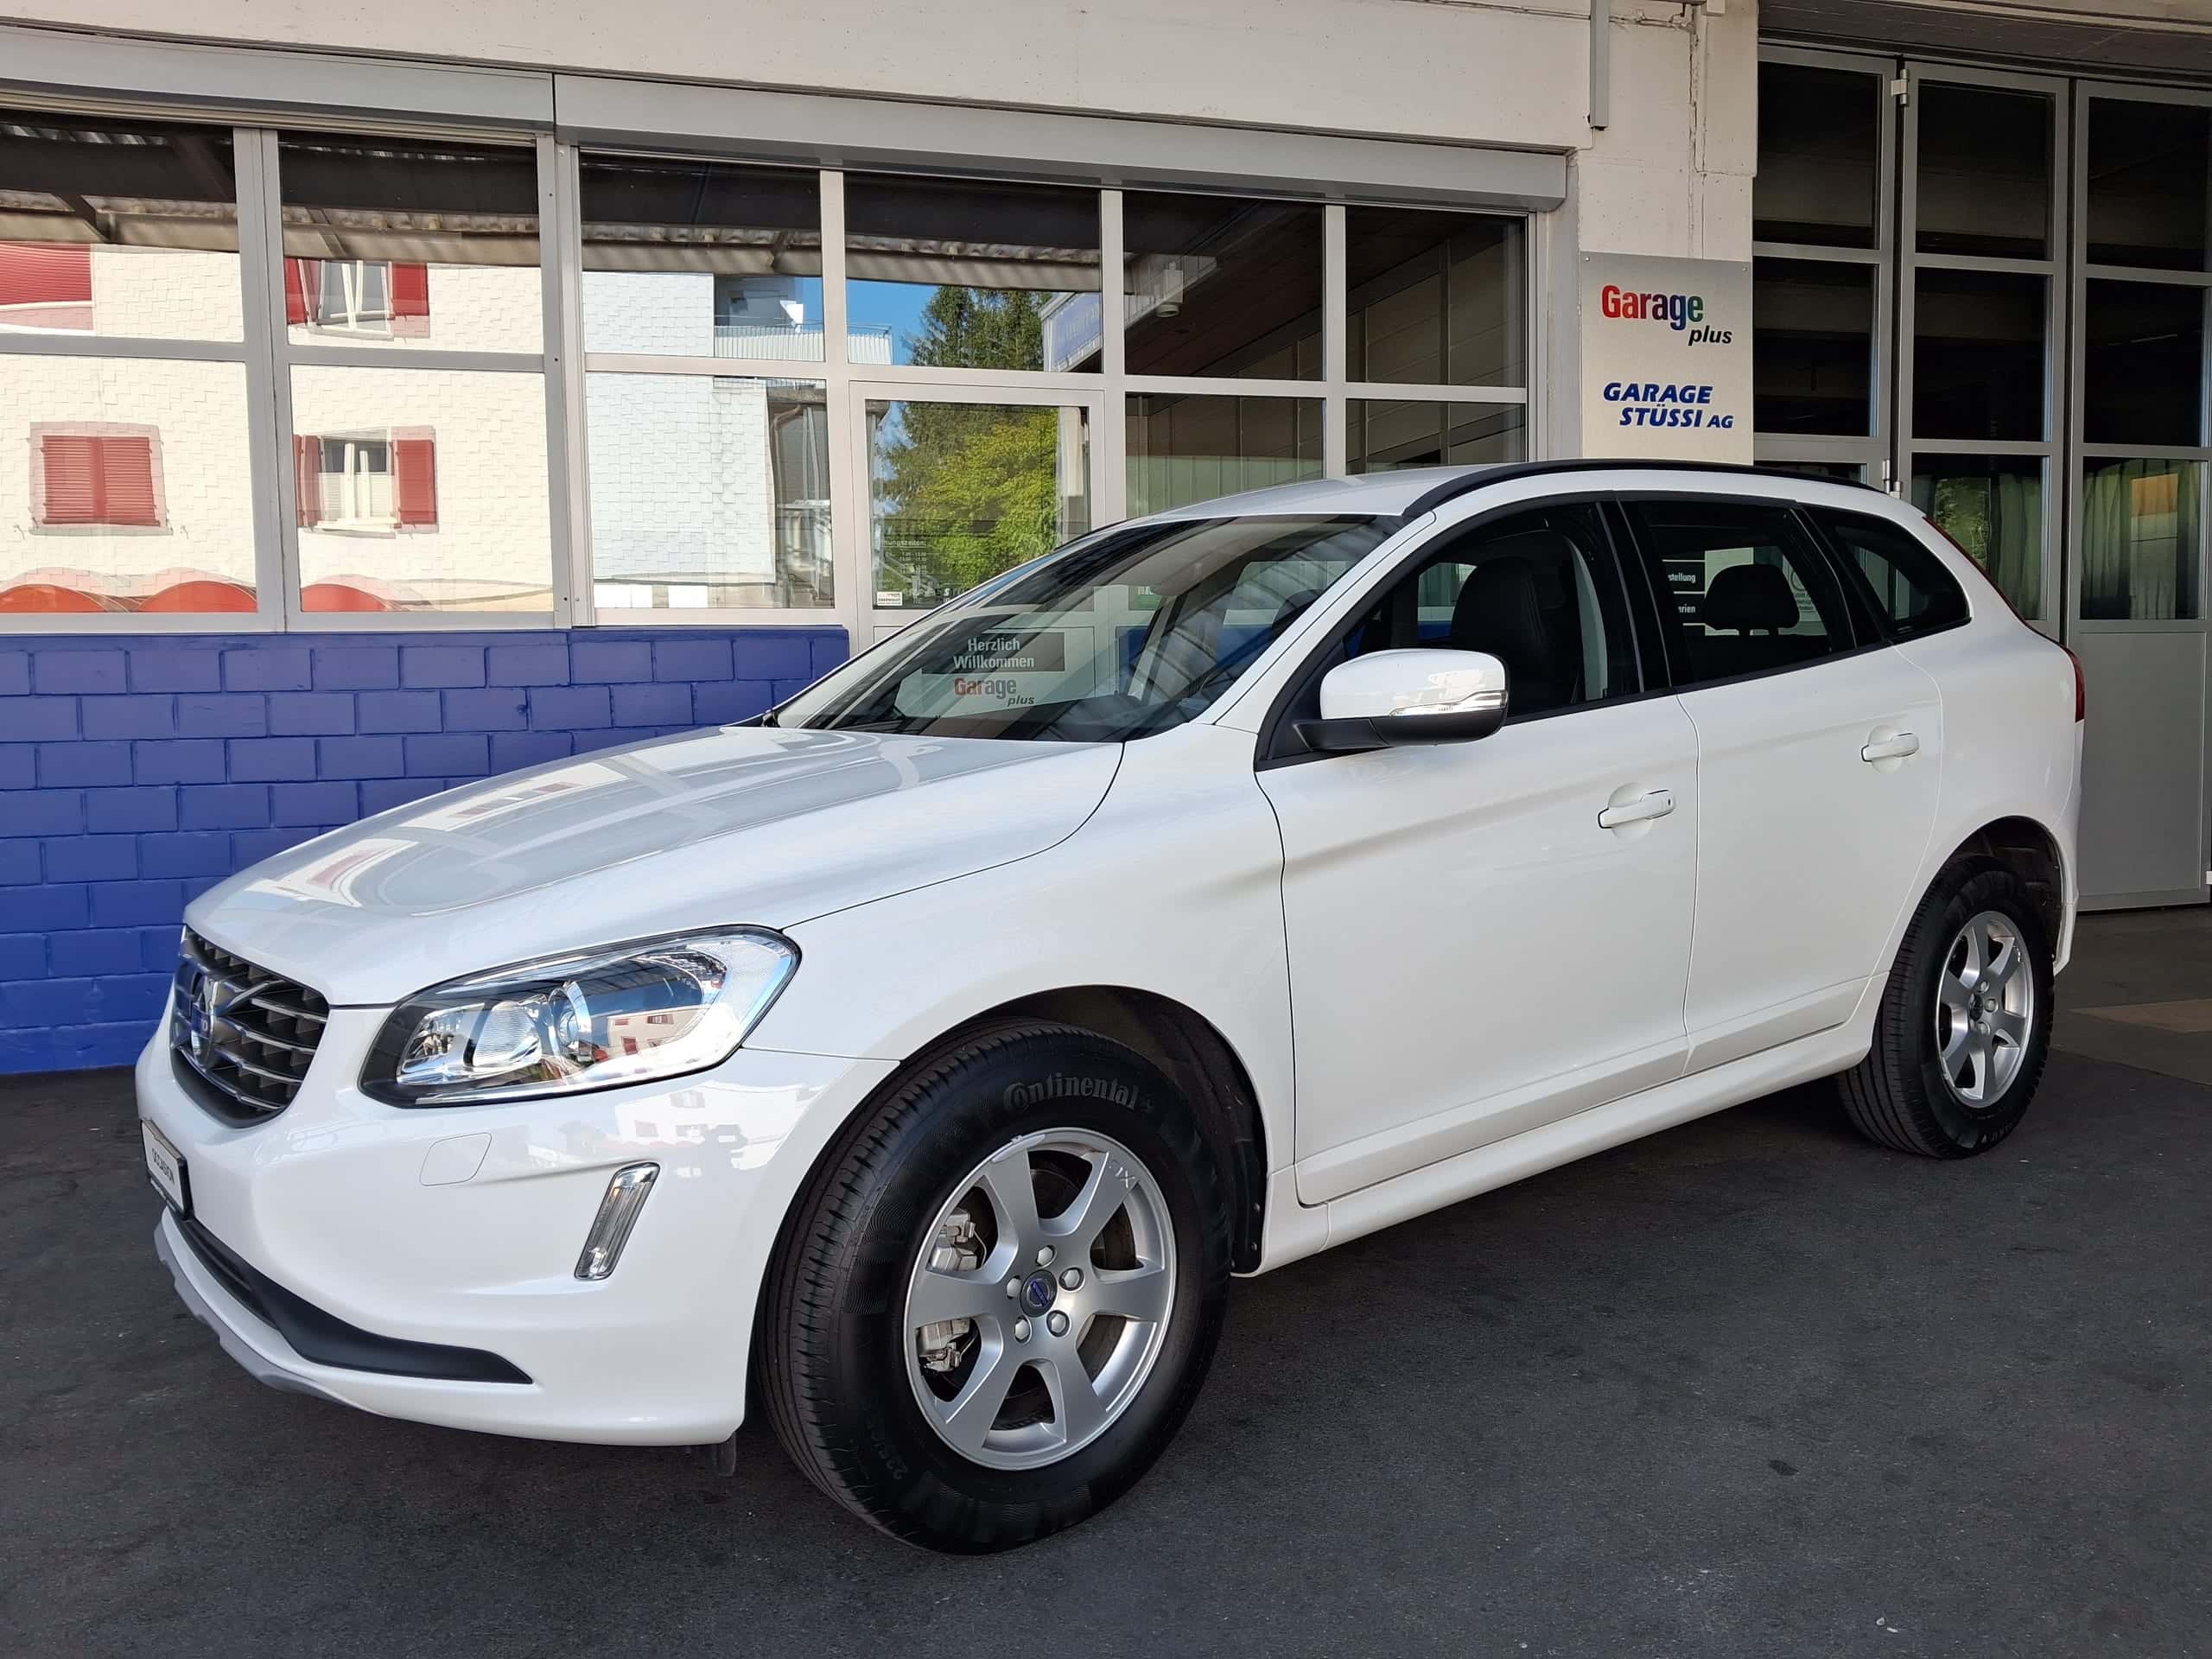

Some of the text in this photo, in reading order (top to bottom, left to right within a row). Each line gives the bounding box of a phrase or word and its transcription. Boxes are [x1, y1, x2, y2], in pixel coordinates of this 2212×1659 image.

[1601, 284, 1704, 331] Garage
[1688, 325, 1733, 346] plus
[1603, 382, 1713, 404] GARAGE
[1619, 404, 1734, 429] STÜSSI AG
[967, 638, 1020, 652] Herzlich
[953, 655, 1035, 670] Willkommen
[954, 677, 1017, 700] Garage
[1007, 695, 1035, 707] plus
[1003, 1071, 1141, 1113] Continental
